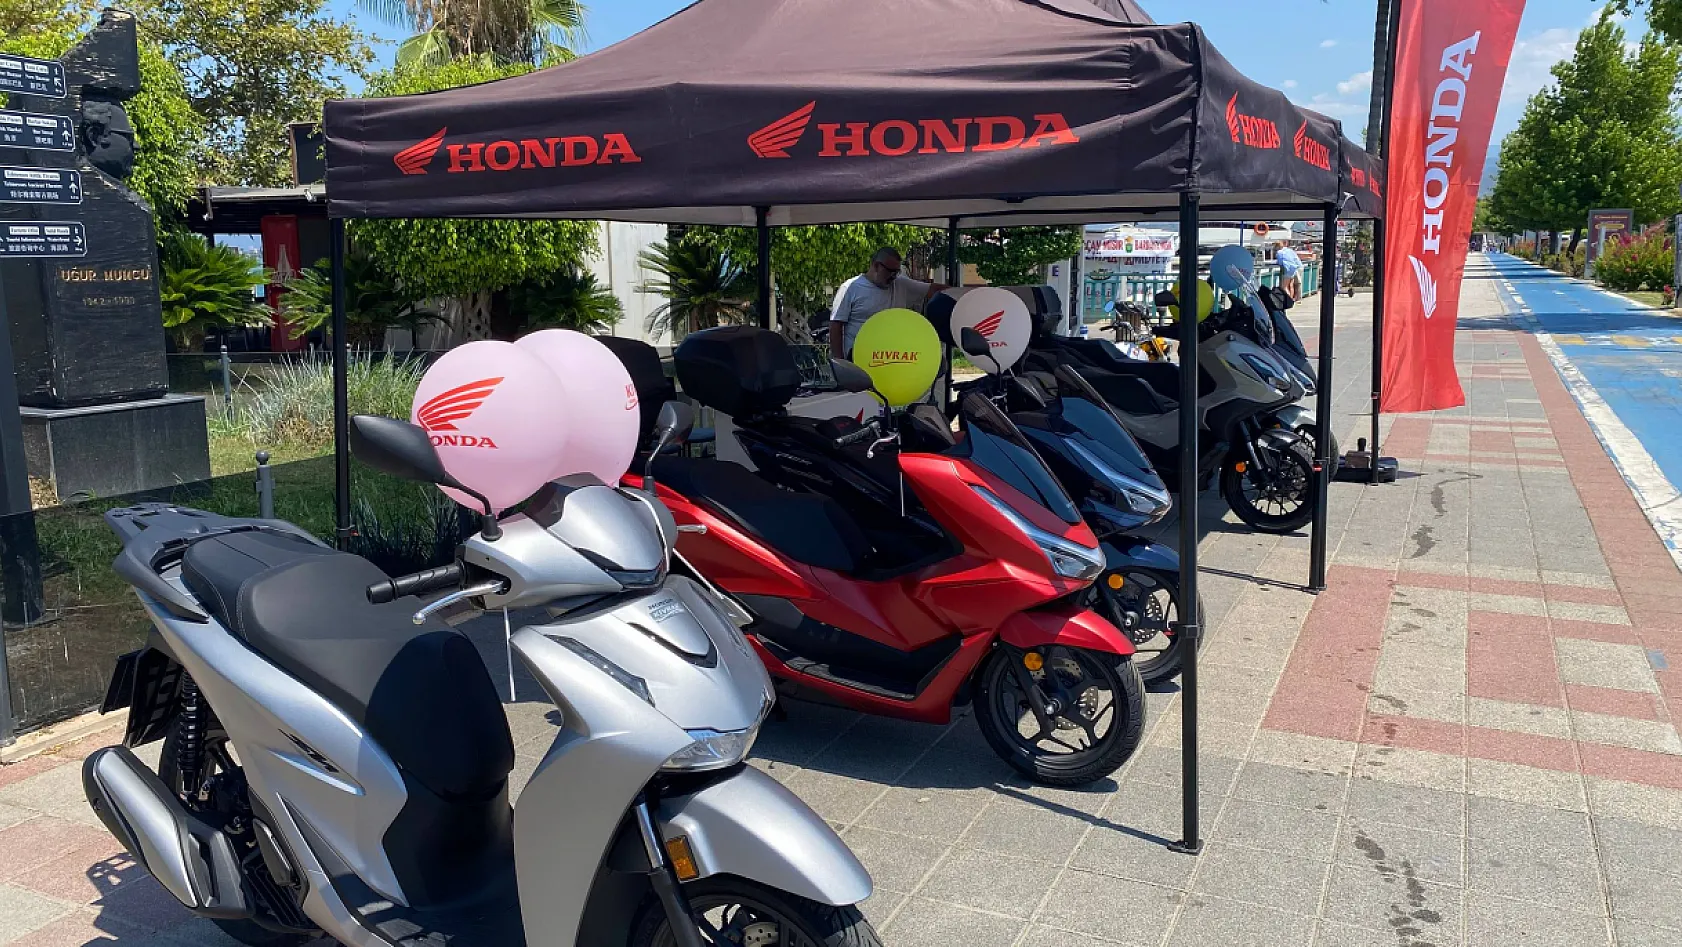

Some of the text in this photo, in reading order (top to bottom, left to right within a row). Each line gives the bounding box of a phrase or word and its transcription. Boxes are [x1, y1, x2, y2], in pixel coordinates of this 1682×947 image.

[817, 112, 1080, 156] HONDA
[1239, 114, 1281, 149] HONDA
[1423, 30, 1481, 255] HONDA
[446, 133, 641, 172] HONDA
[1303, 135, 1331, 171] HONDA
[872, 351, 918, 361] KIVRAK
[429, 435, 499, 449] ONDA
